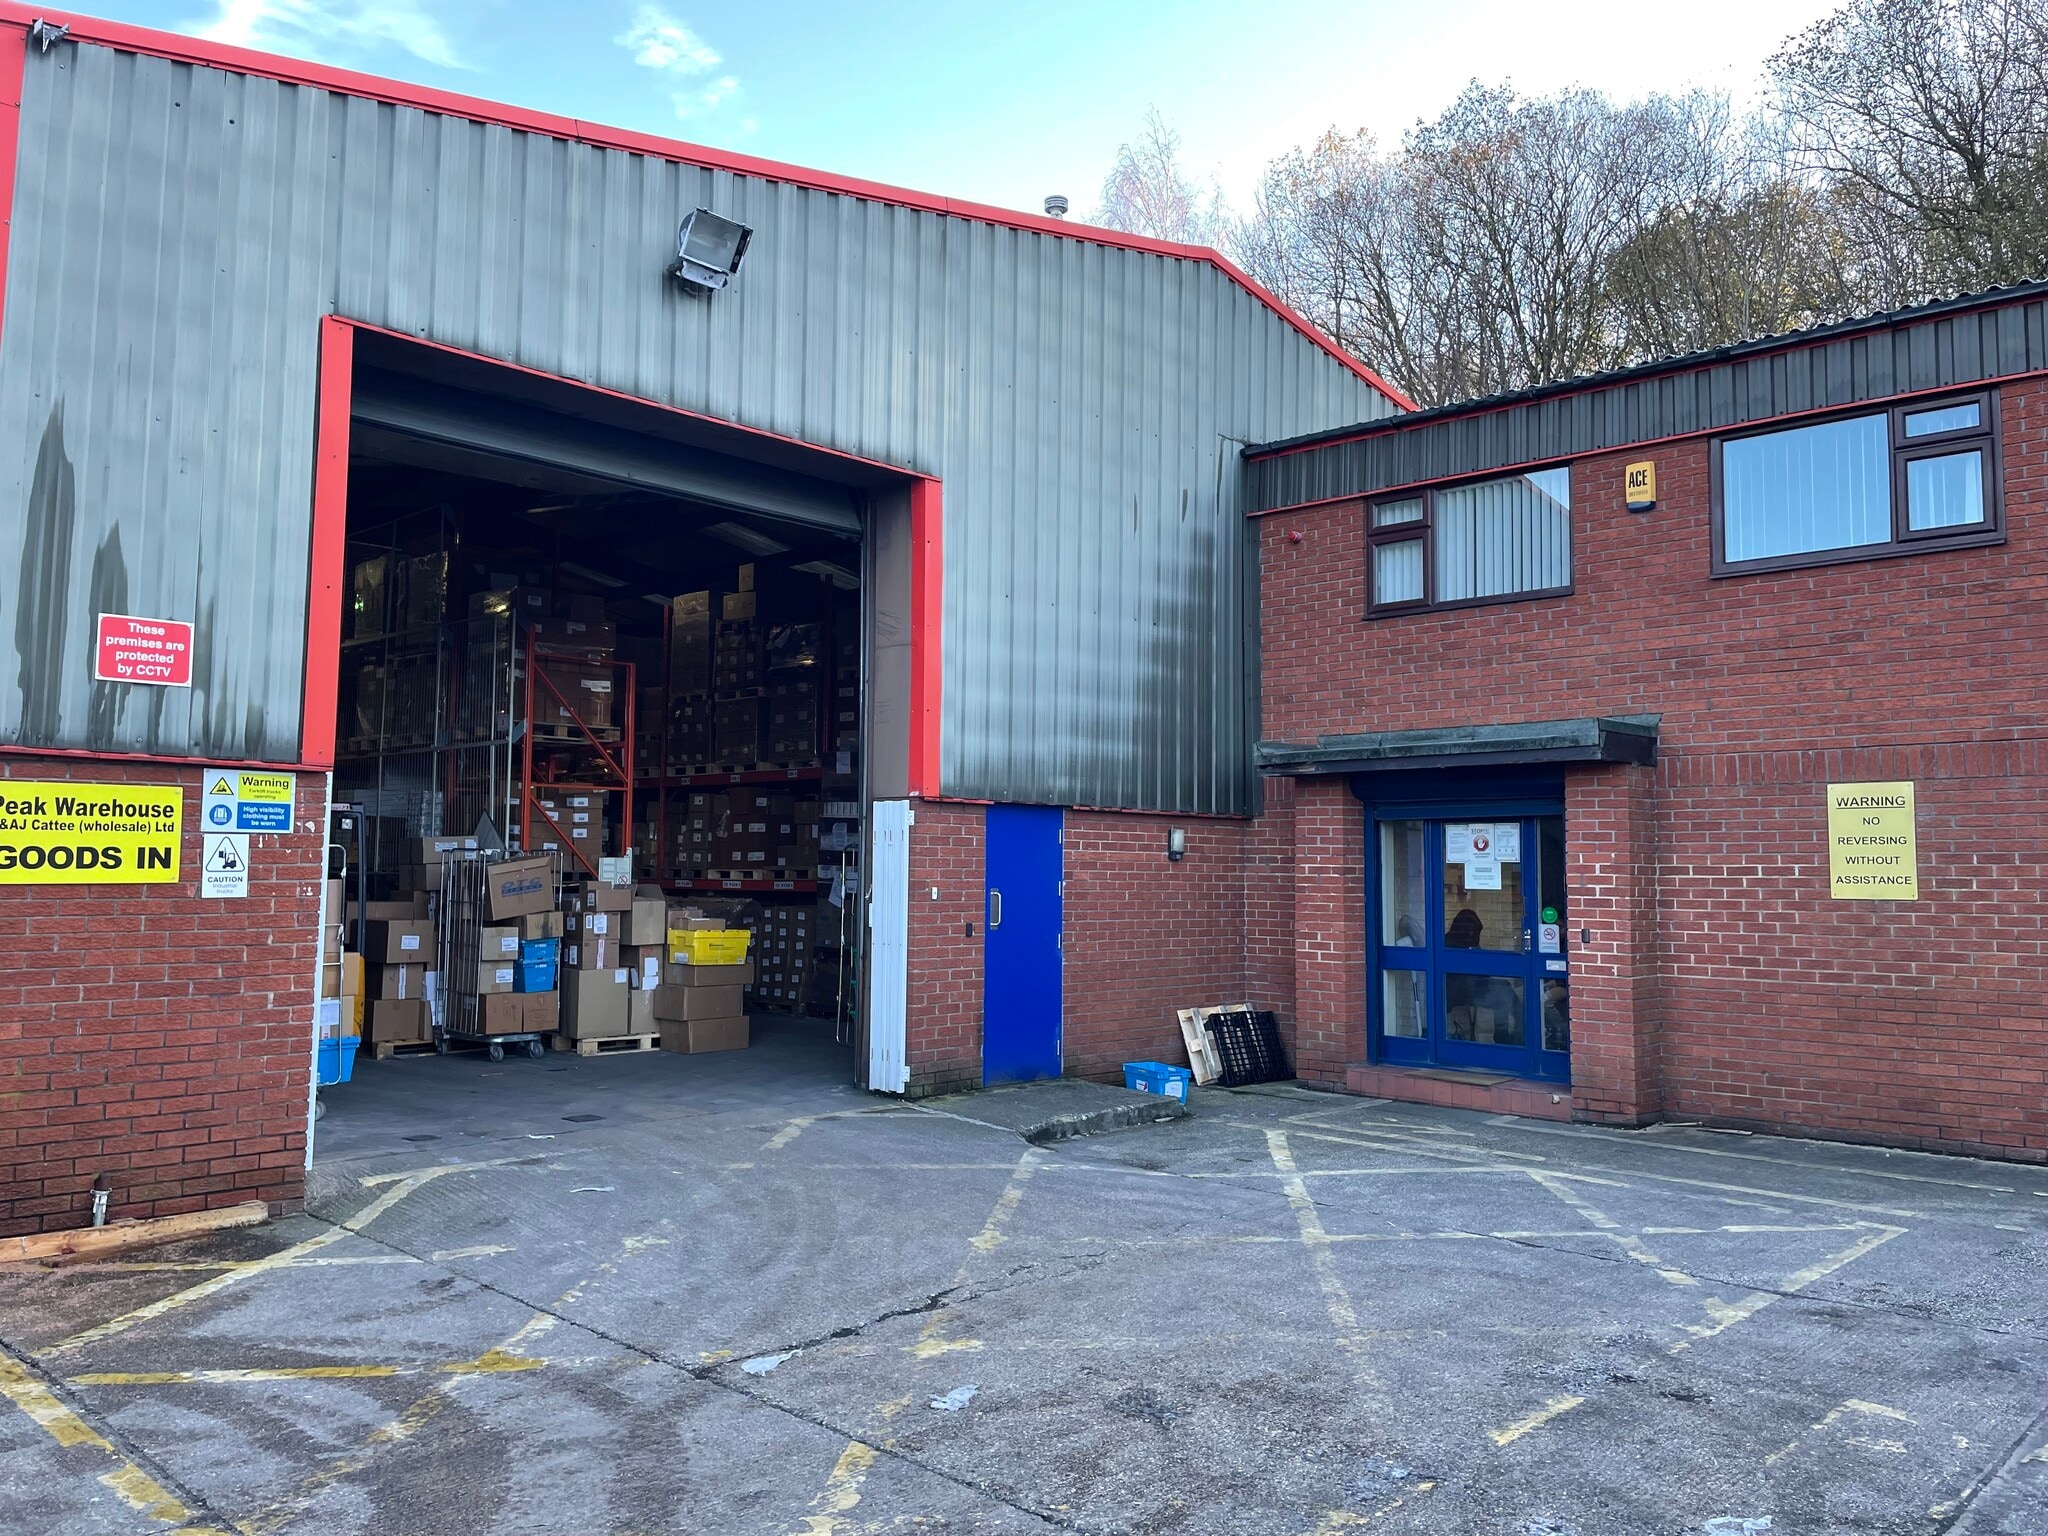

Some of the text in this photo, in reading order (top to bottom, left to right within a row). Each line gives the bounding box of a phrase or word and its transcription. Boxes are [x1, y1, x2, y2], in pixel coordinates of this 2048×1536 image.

[1628, 469, 1648, 488] ACE
[127, 622, 165, 636] These
[105, 636, 185, 651] premises are
[115, 651, 175, 664] protected
[117, 663, 171, 677] by CCTV
[242, 776, 289, 790] Warning
[55, 797, 175, 818] Warehouse
[1836, 796, 1906, 807] WARNING
[242, 813, 269, 821] clothing
[243, 806, 285, 815] High visibility
[31, 819, 75, 831] Cattee
[79, 820, 151, 835] (wholesale)
[155, 821, 175, 833] Ltd
[1862, 816, 1880, 825] NO
[1837, 836, 1907, 846] REVERSING
[0, 845, 172, 870] GOODS IN
[1845, 856, 1900, 865] WITHOUT
[1836, 875, 1912, 885] ASSISTANCE
